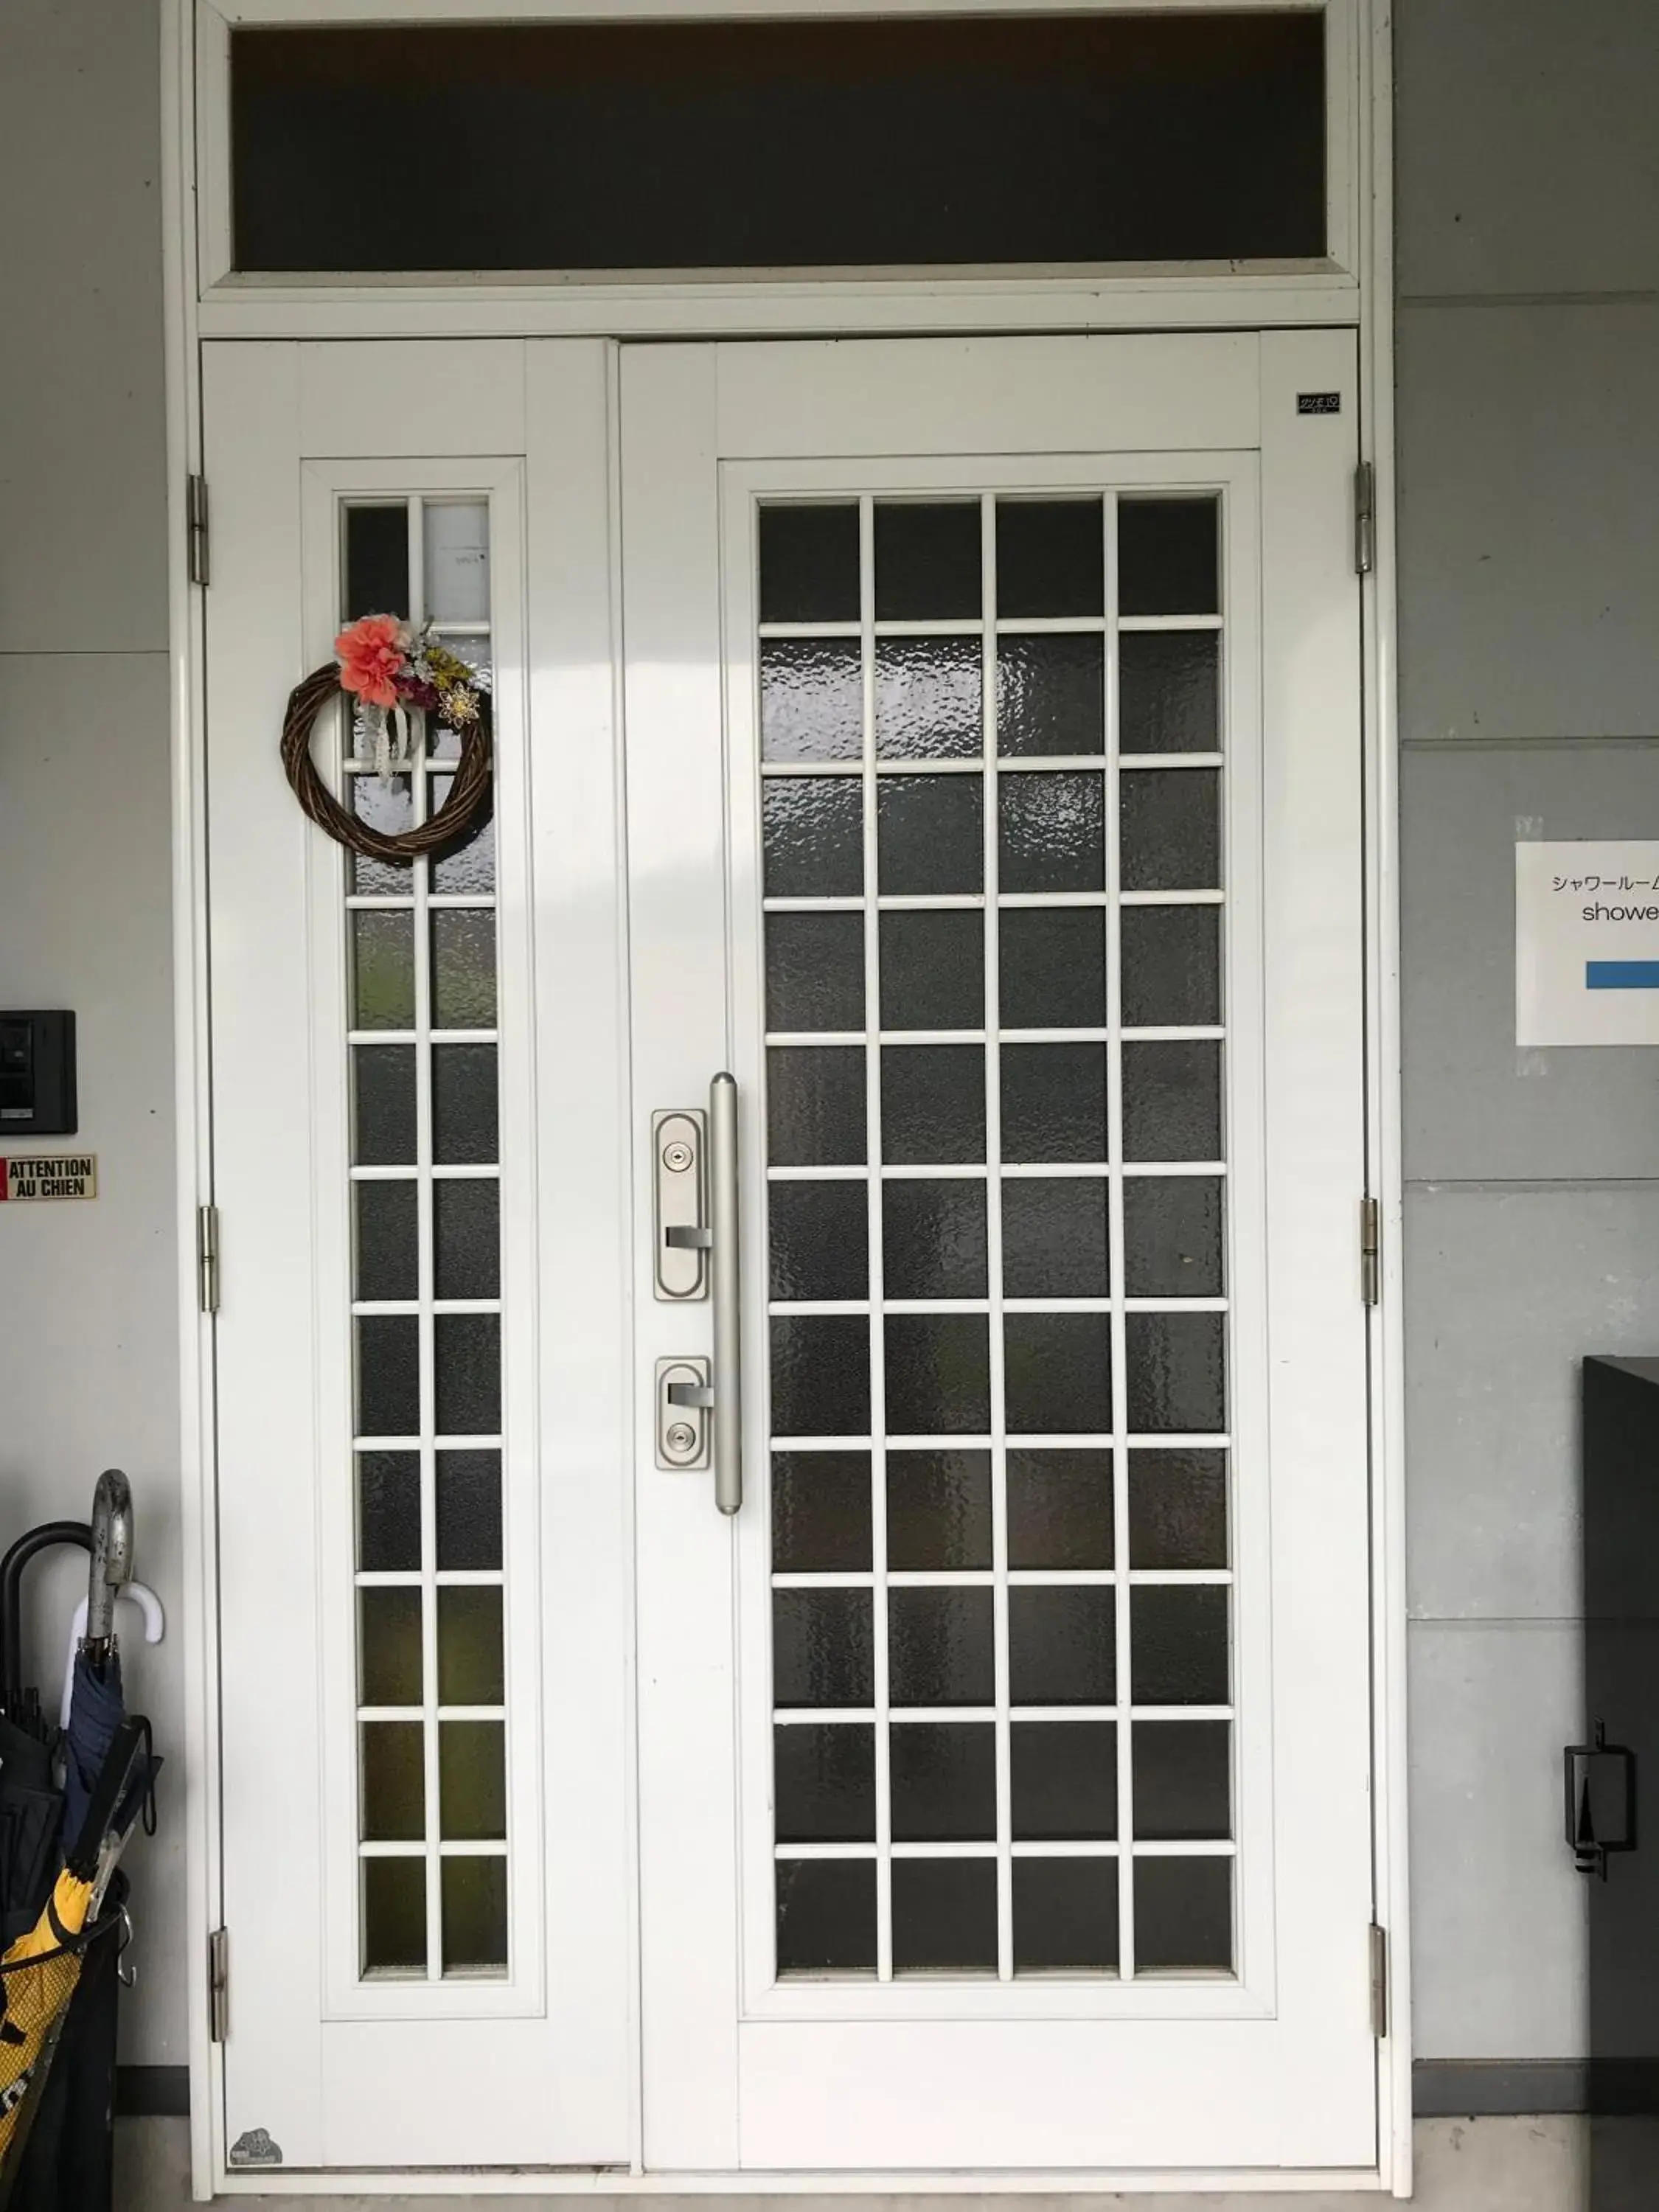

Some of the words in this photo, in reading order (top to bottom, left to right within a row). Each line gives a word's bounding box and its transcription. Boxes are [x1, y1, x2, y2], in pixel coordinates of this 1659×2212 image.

[9, 1158, 91, 1178] ATTENTION
[16, 1179, 36, 1197] AU
[41, 1178, 85, 1196] CHIEN
